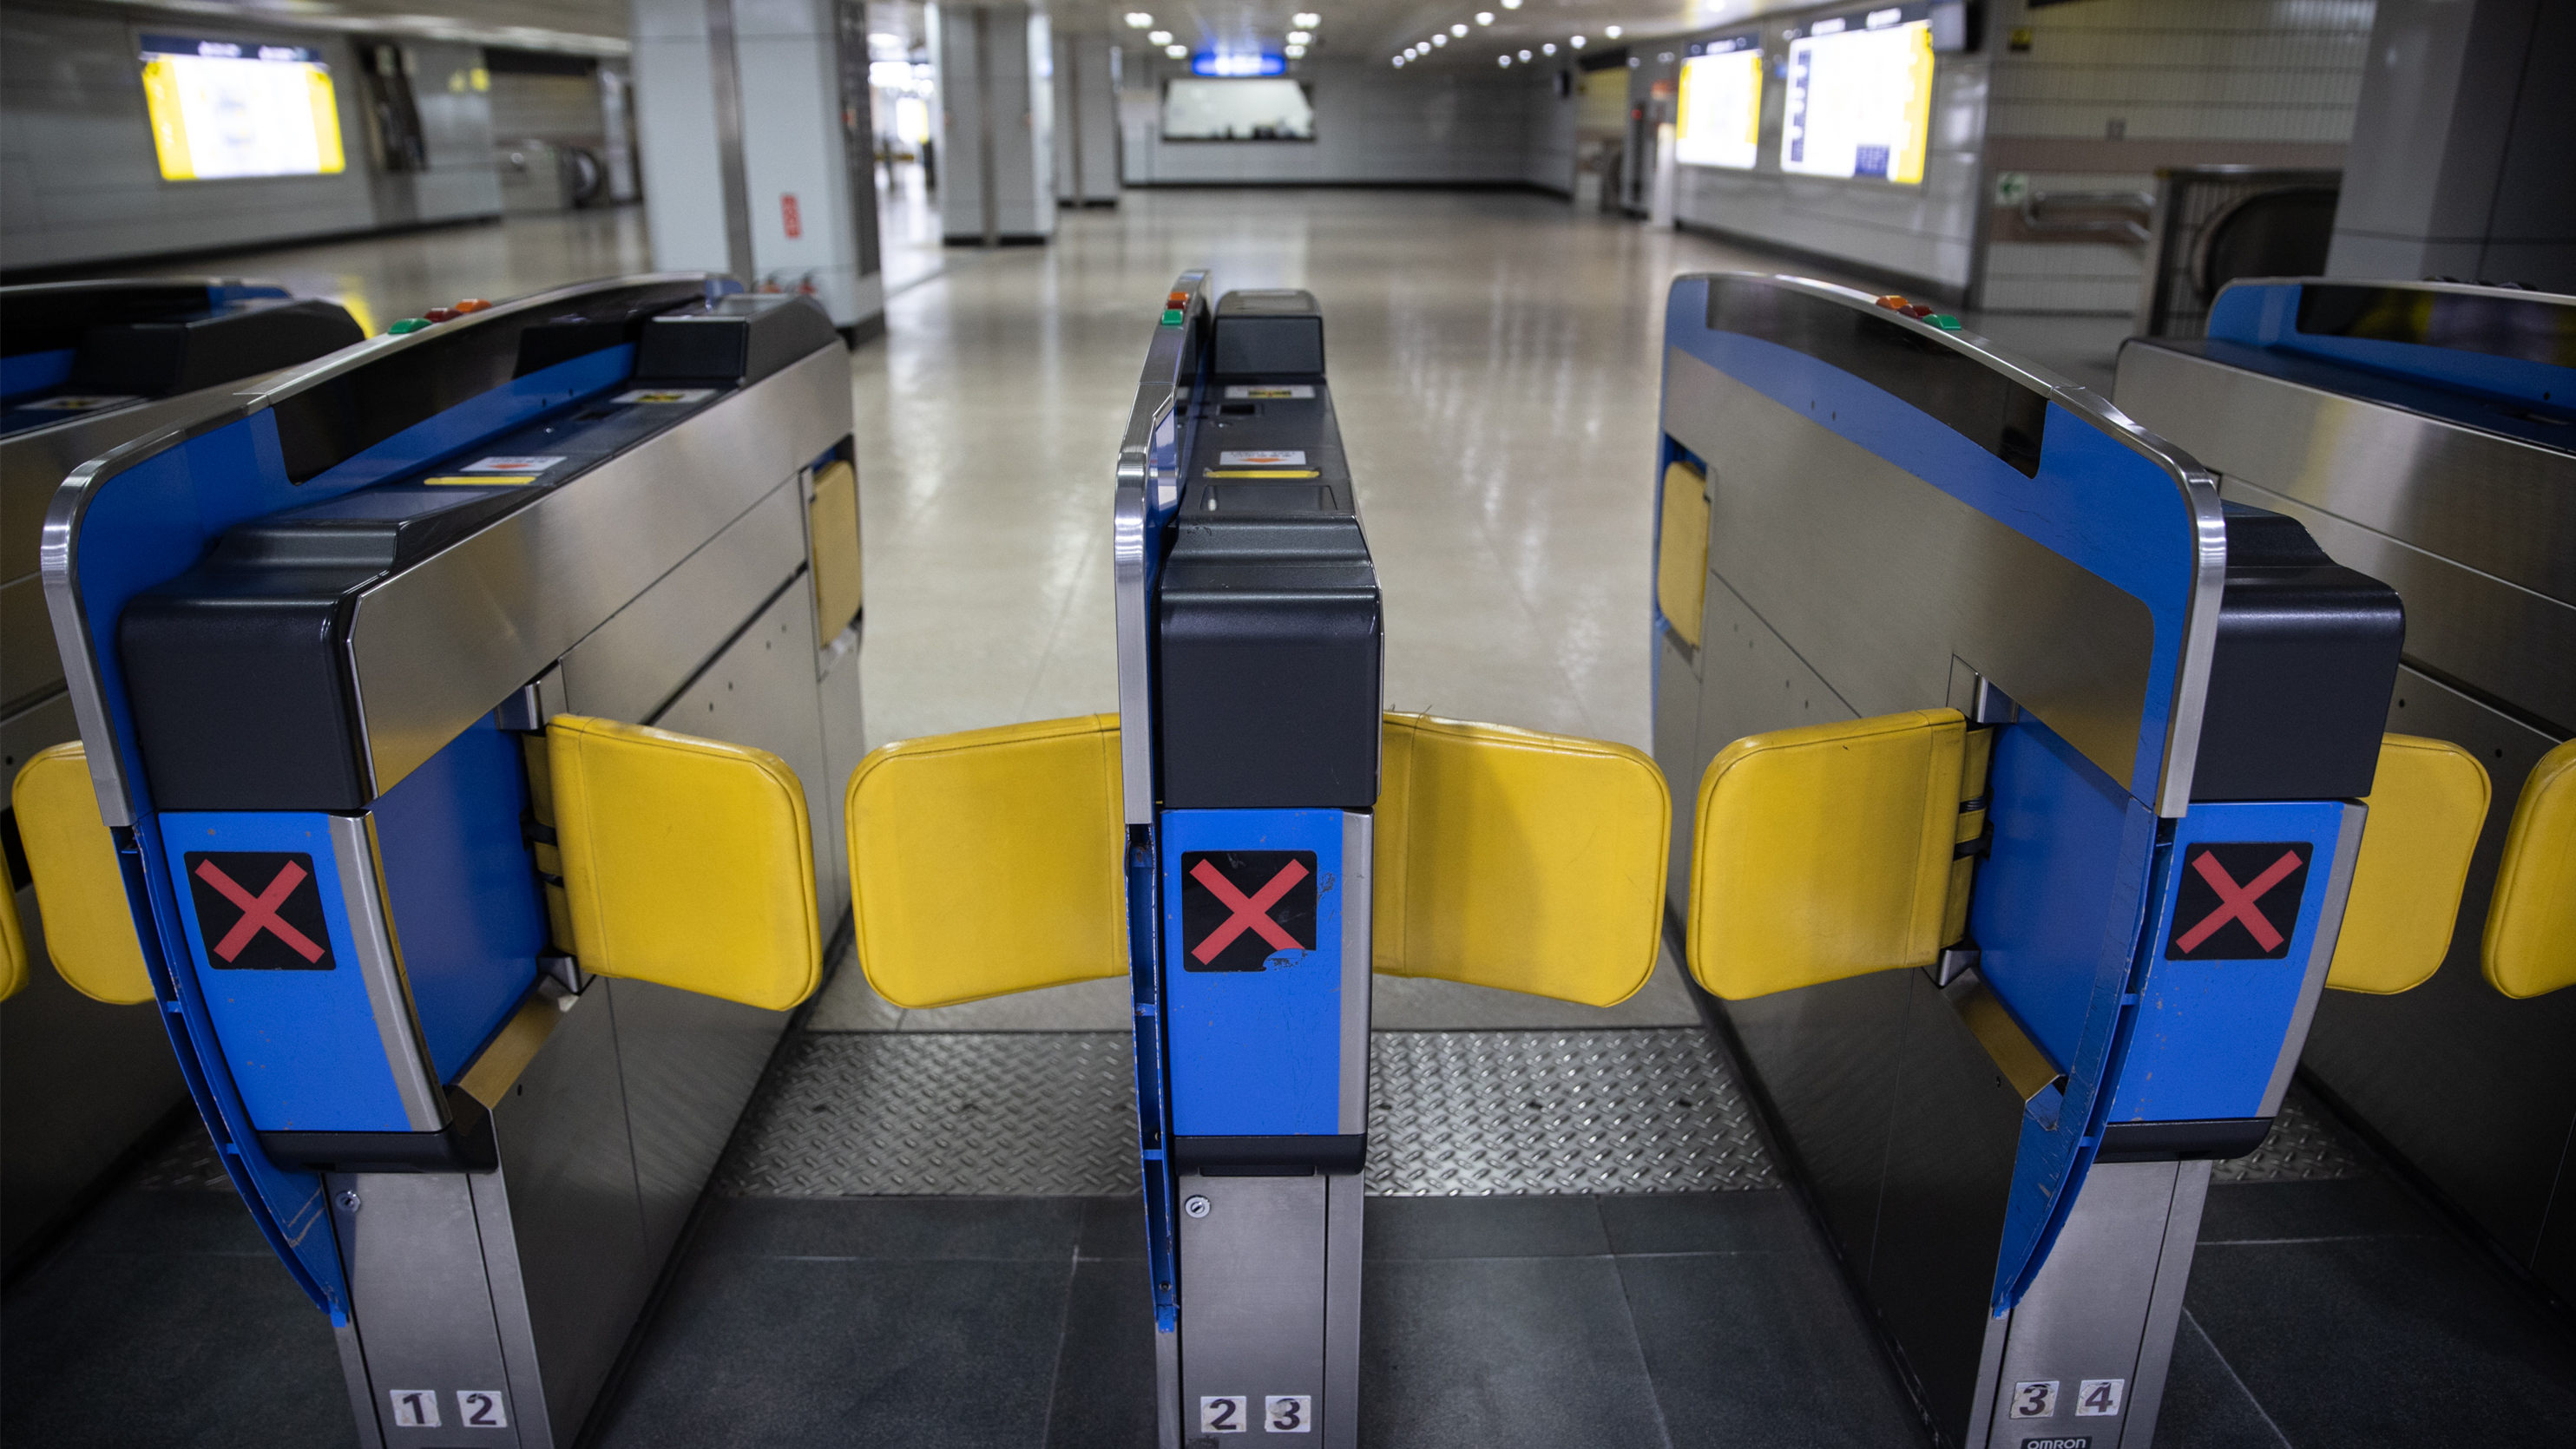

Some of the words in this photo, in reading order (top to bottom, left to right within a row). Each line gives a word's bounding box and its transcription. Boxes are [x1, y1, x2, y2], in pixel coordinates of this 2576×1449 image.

[403, 1393, 425, 1425] 1
[466, 1393, 497, 1426] 2
[1209, 1398, 1237, 1431] 2
[1272, 1398, 1301, 1431] 3
[2019, 1383, 2051, 1416] 3
[2084, 1382, 2113, 1413] 4
